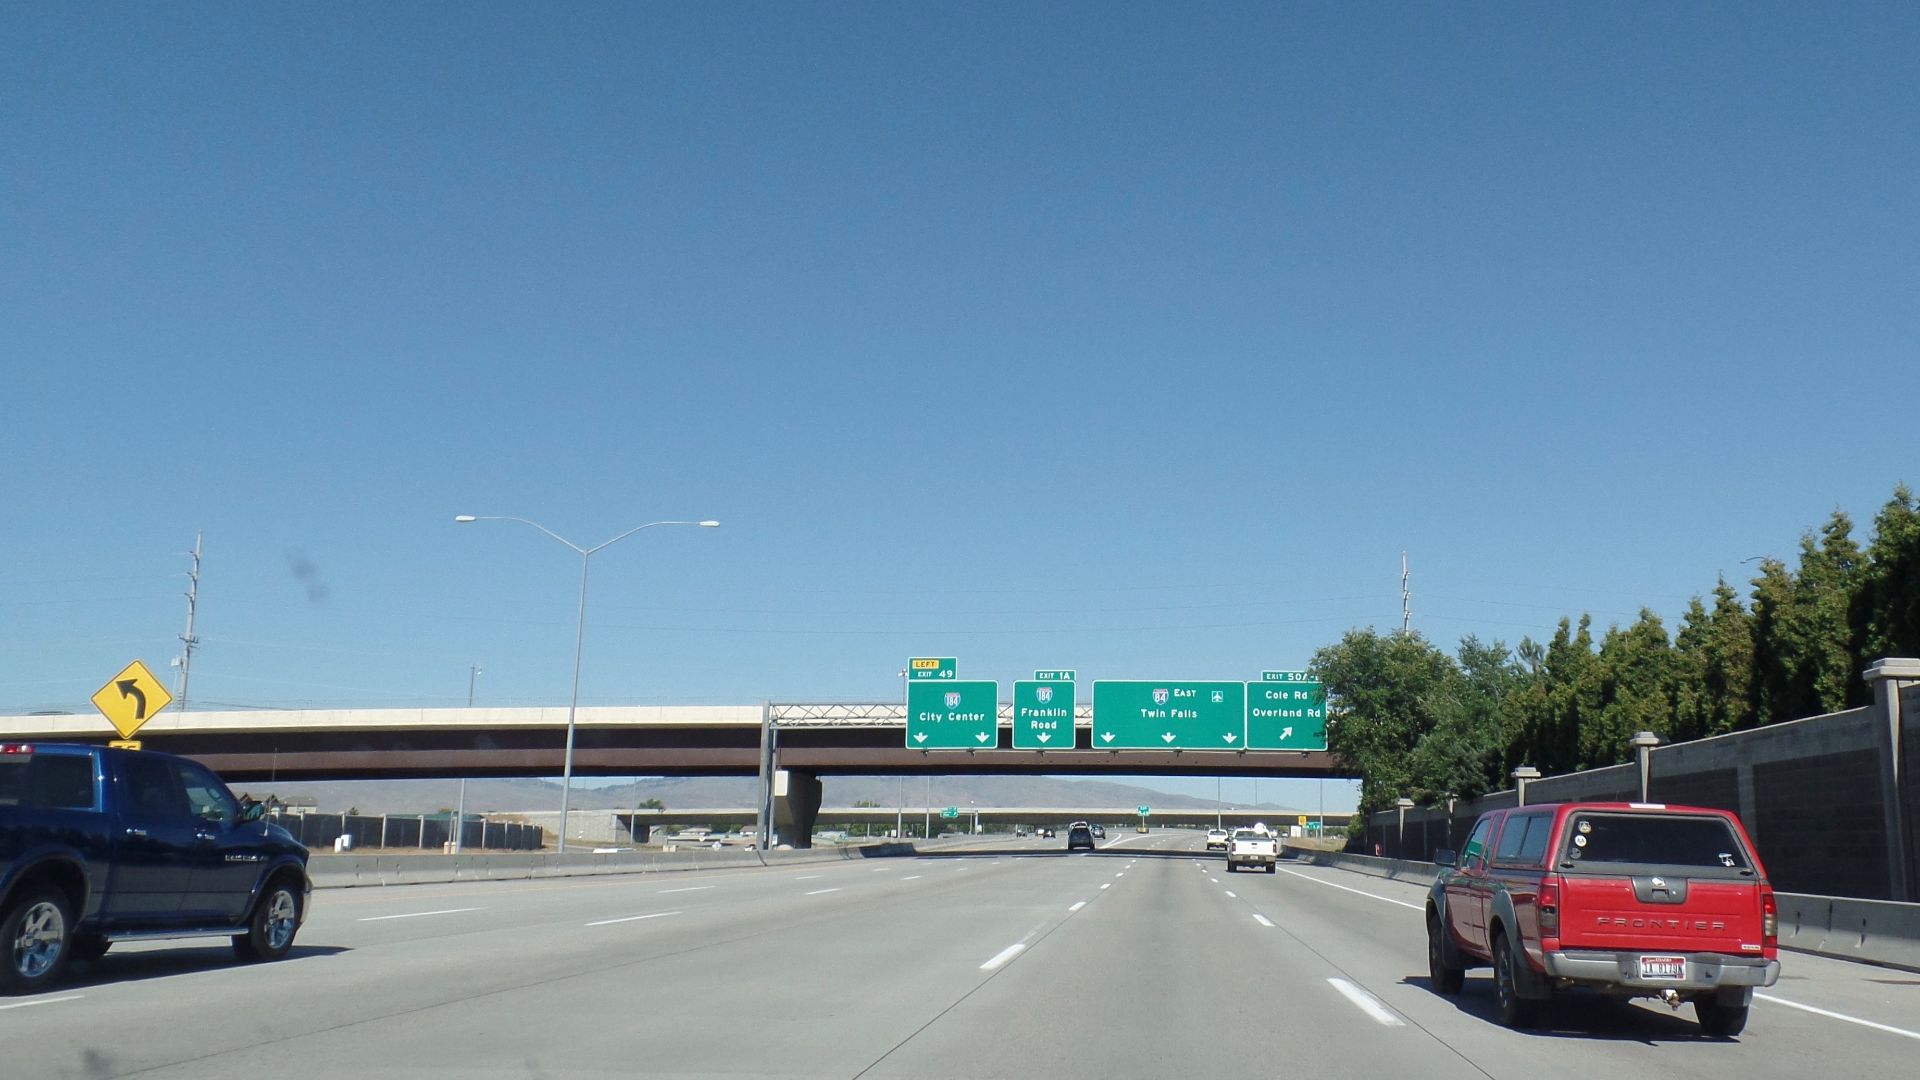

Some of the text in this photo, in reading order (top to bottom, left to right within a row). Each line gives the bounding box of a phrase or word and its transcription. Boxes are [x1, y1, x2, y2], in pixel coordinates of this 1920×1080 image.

[939, 670, 953, 678] 49
[1059, 672, 1070, 680] 1A
[1039, 691, 1051, 701] 184
[1155, 693, 1167, 702] 84
[1266, 690, 1308, 700] Cole Rd
[946, 695, 959, 706] 184
[1021, 708, 1067, 717] Franklin
[1141, 709, 1198, 718] Twin Falls
[1253, 708, 1321, 718] Overland Rd
[919, 712, 985, 723] City Center
[1031, 720, 1057, 729] Road
[1596, 916, 1726, 932] FRONTIER
